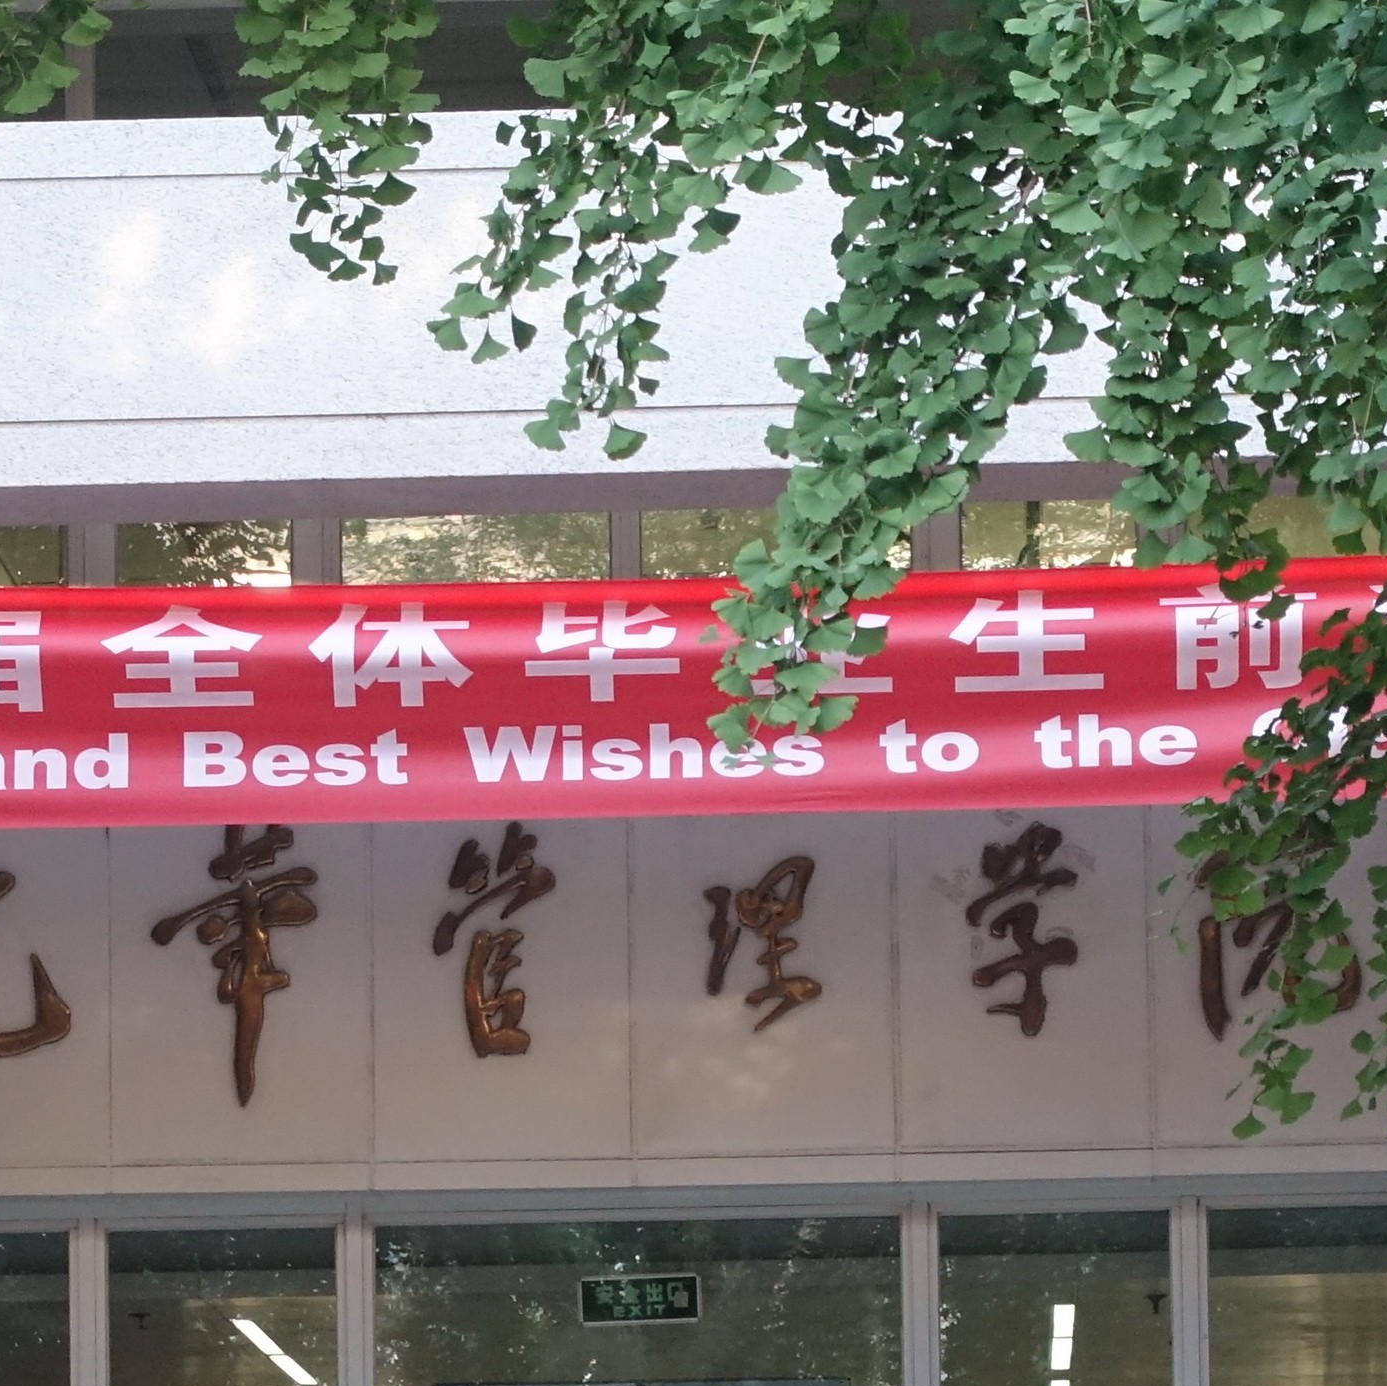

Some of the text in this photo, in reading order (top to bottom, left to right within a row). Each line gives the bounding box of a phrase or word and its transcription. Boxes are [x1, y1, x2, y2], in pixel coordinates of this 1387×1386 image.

[183, 730, 409, 787] Best
[468, 724, 824, 782] Wishes
[879, 719, 980, 775] to
[1034, 715, 1198, 769] the
